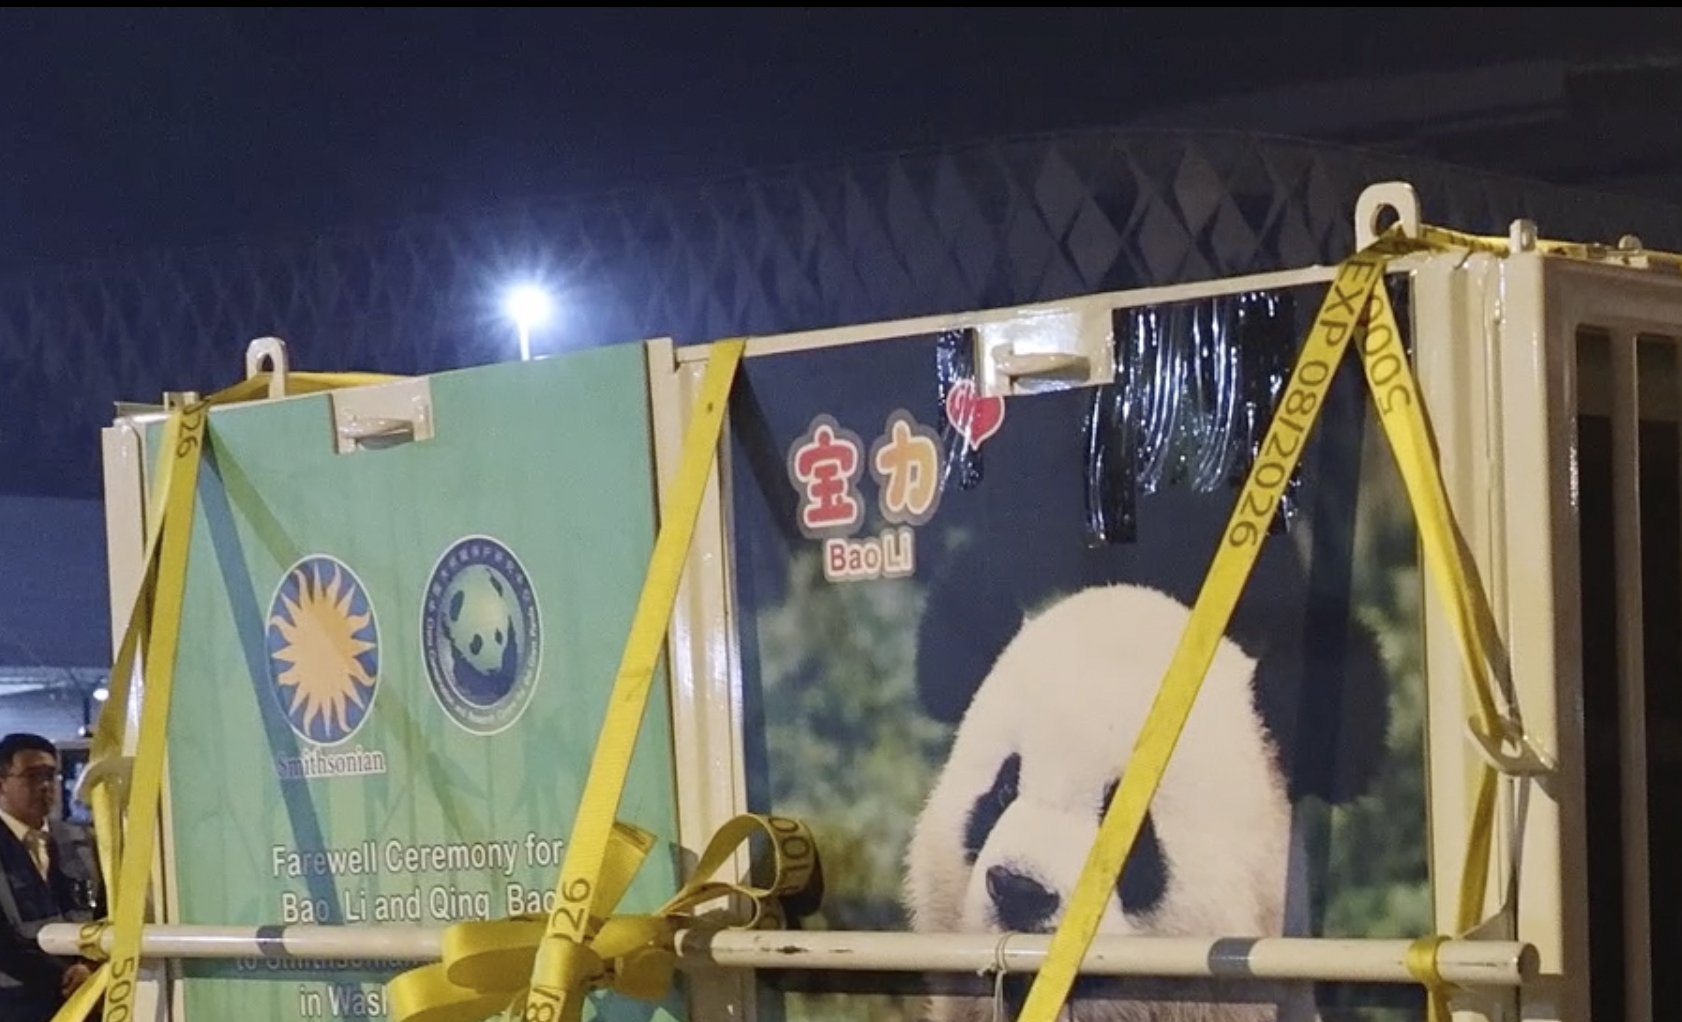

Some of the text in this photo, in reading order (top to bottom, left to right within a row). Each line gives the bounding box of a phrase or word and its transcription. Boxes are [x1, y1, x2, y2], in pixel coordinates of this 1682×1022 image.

[1228, 259, 1377, 549] EXP 08/2026
[796, 420, 938, 527] 宝力
[829, 532, 912, 572] Bao Li
[278, 746, 385, 777] Smithsonian
[272, 832, 564, 878] Farewell Ceremony for
[281, 892, 330, 923] Bao
[344, 889, 367, 922] Li
[374, 887, 422, 920] and
[300, 984, 322, 1017] in
